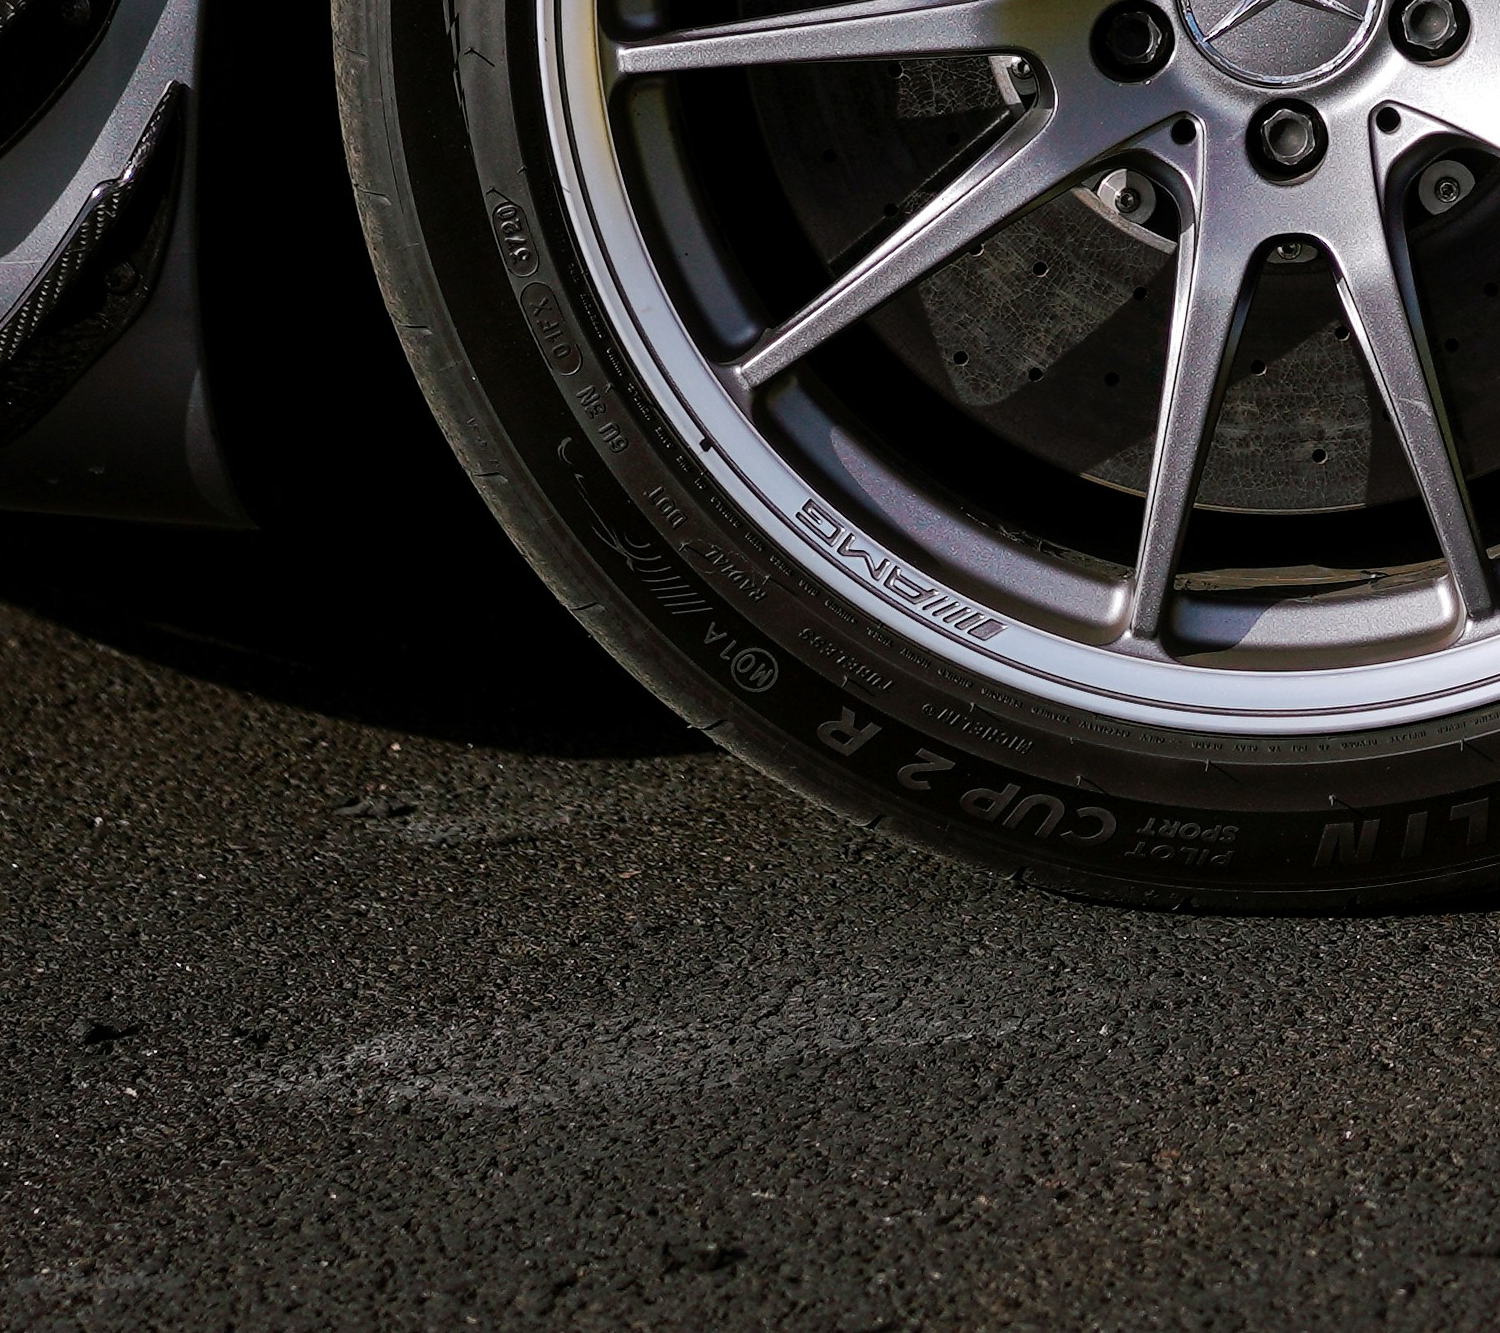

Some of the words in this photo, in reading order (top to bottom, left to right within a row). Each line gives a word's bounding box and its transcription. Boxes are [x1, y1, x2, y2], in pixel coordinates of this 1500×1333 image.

[642, 480, 690, 533] DOT
[793, 496, 935, 611] AMG
[811, 706, 884, 758] R
[891, 746, 957, 796] 2
[955, 772, 1119, 851] CUP
[1134, 813, 1239, 844] SPORT
[1123, 838, 1233, 869] PILOT
